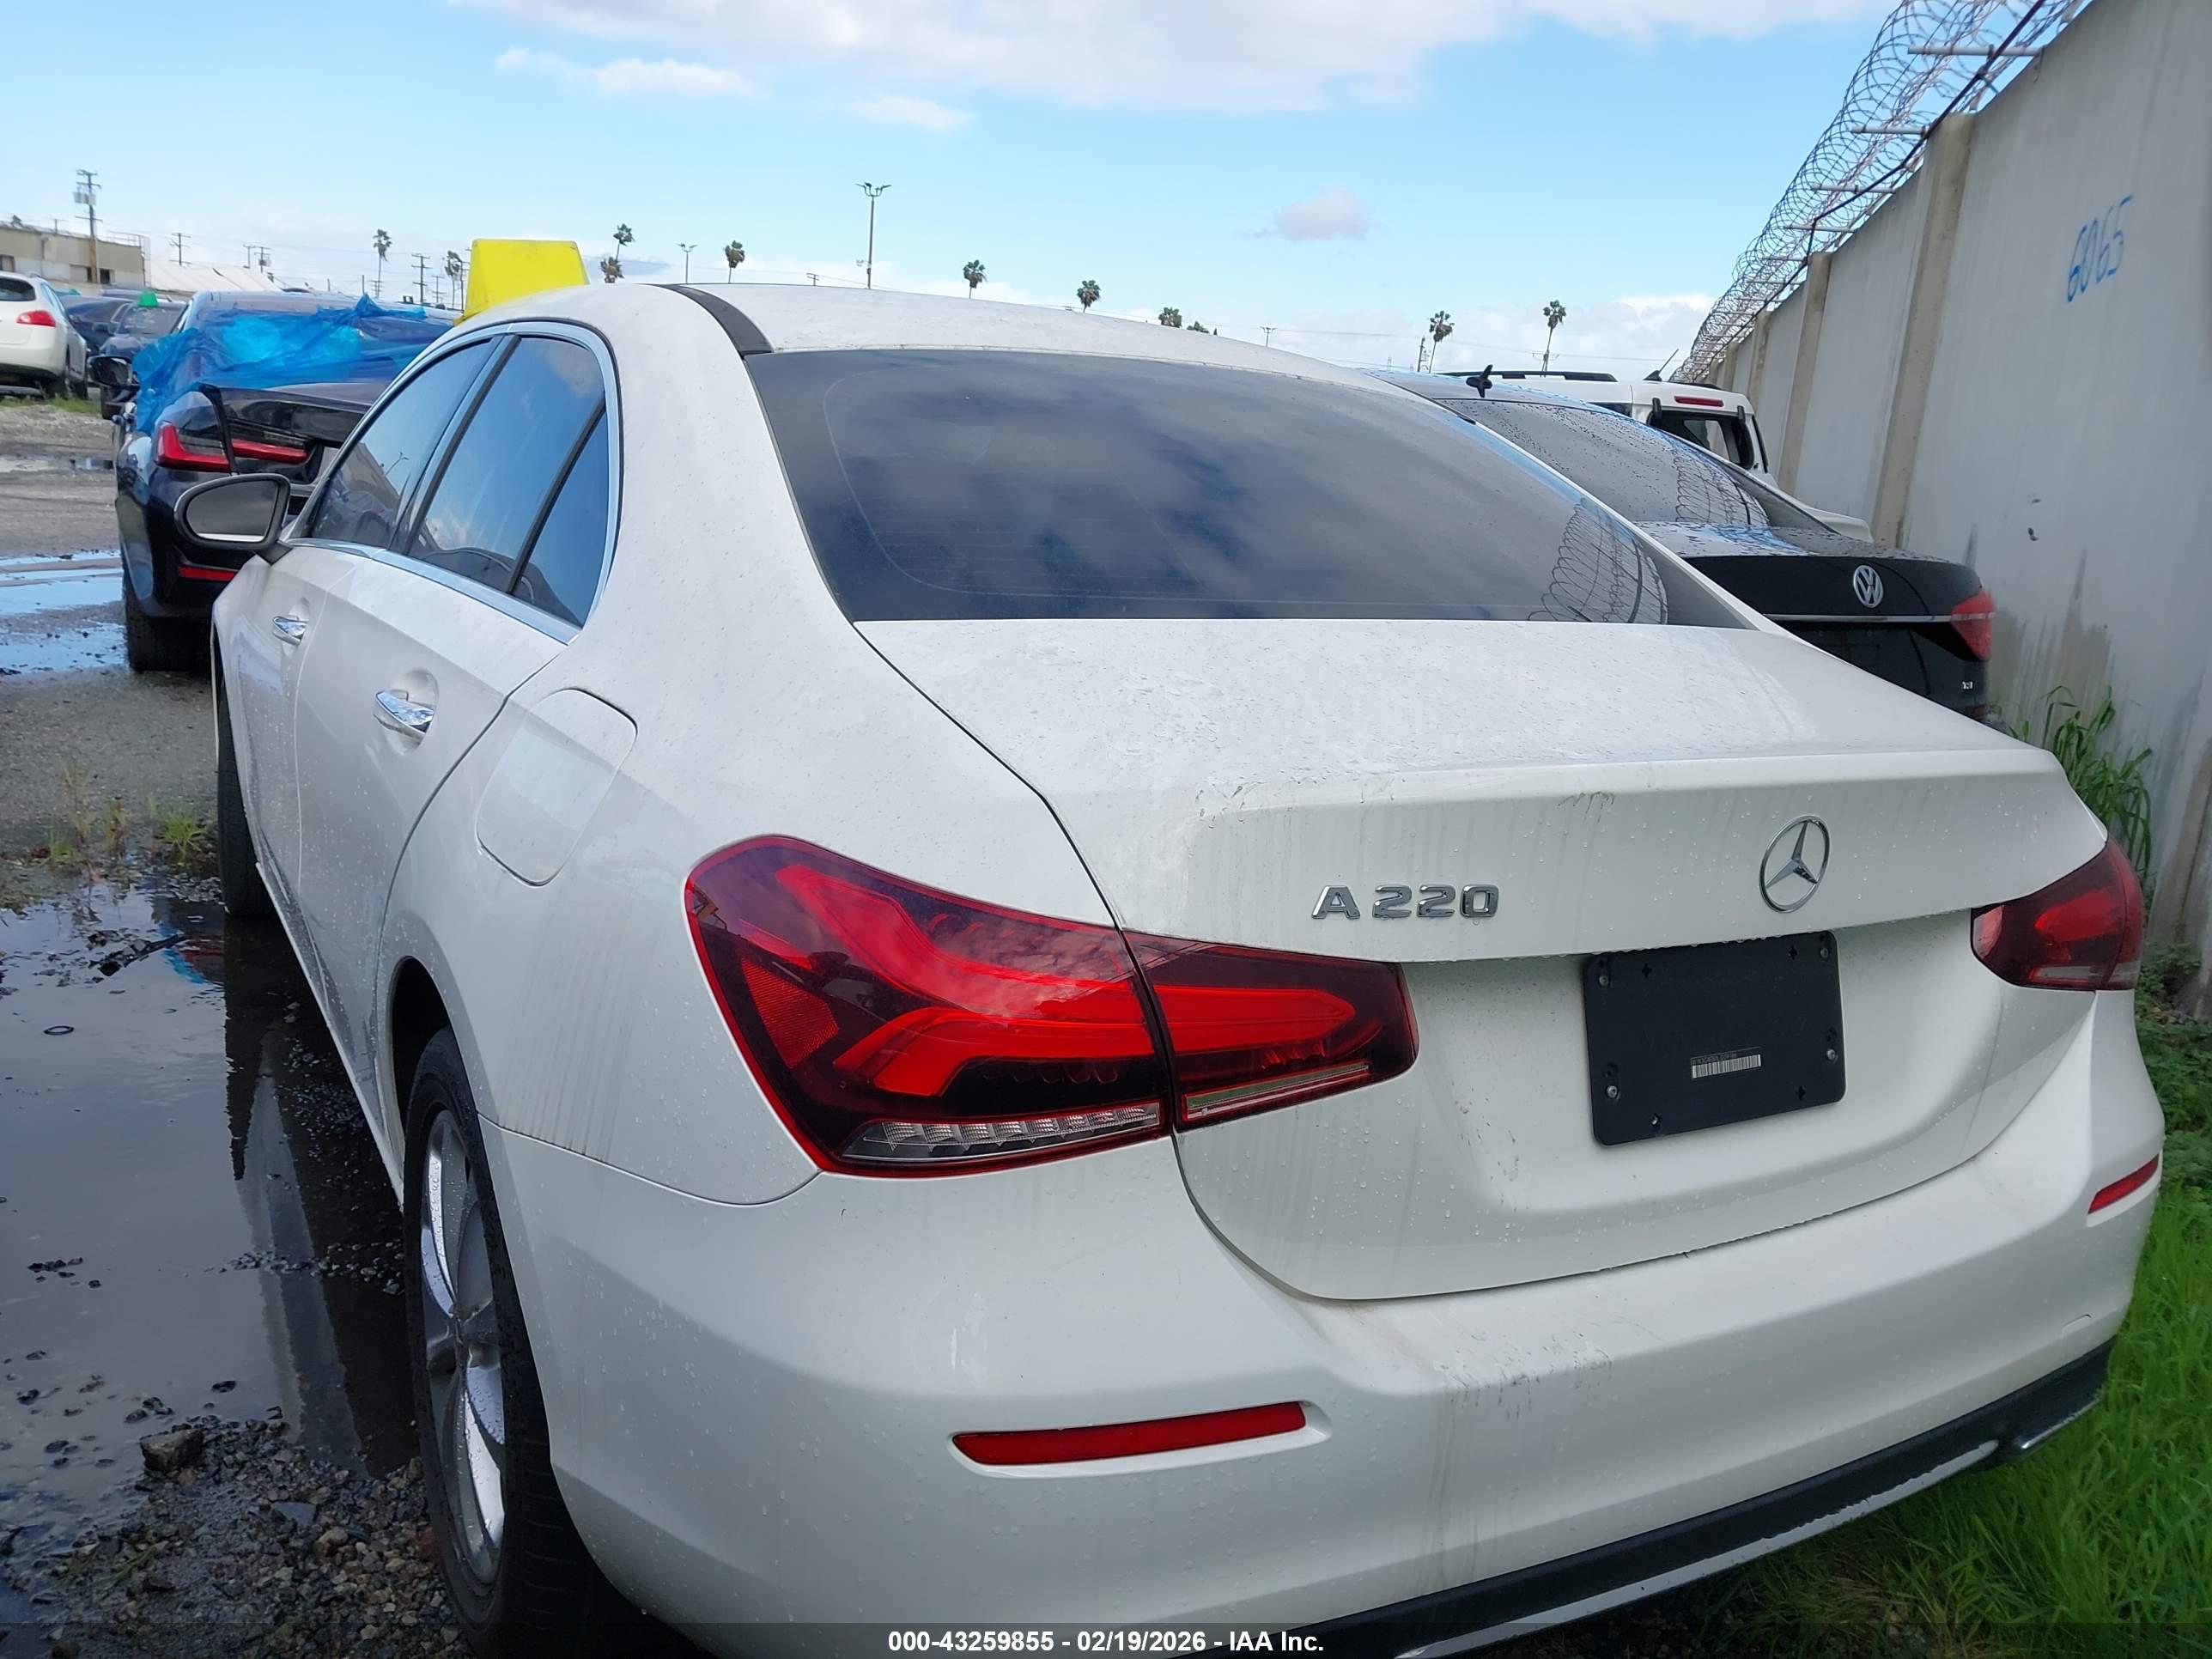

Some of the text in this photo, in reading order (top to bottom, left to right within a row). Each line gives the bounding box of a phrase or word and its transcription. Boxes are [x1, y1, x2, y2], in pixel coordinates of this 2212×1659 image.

[2067, 194, 2133, 302] 6065
[1854, 565, 1883, 608] VW
[1311, 884, 1499, 920] A 220
